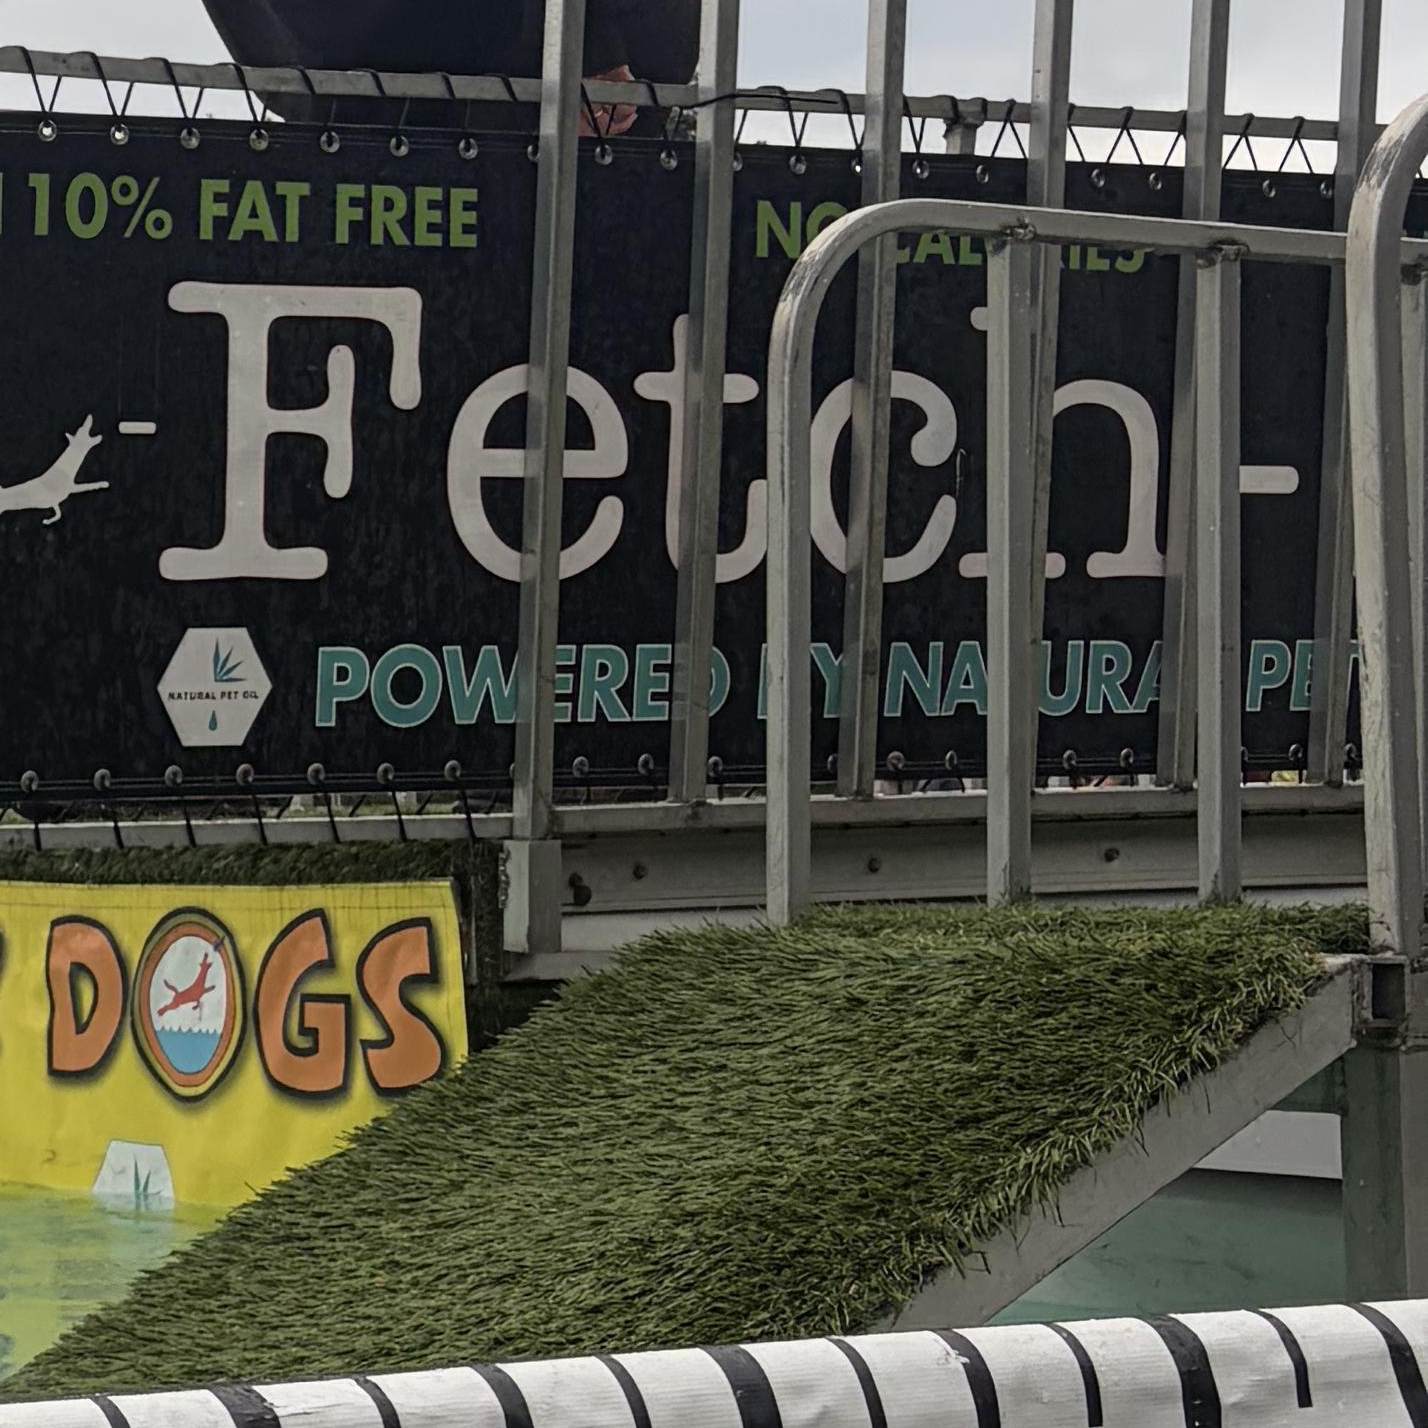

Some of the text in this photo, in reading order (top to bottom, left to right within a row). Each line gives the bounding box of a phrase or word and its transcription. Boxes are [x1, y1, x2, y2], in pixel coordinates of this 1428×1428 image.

[199, 178, 311, 242] FAT
[335, 183, 478, 248] FREE
[220, 690, 239, 700] PET
[757, 641, 844, 720] Y
[883, 639, 1164, 717] NAURA
[46, 905, 442, 1102] DOGS
